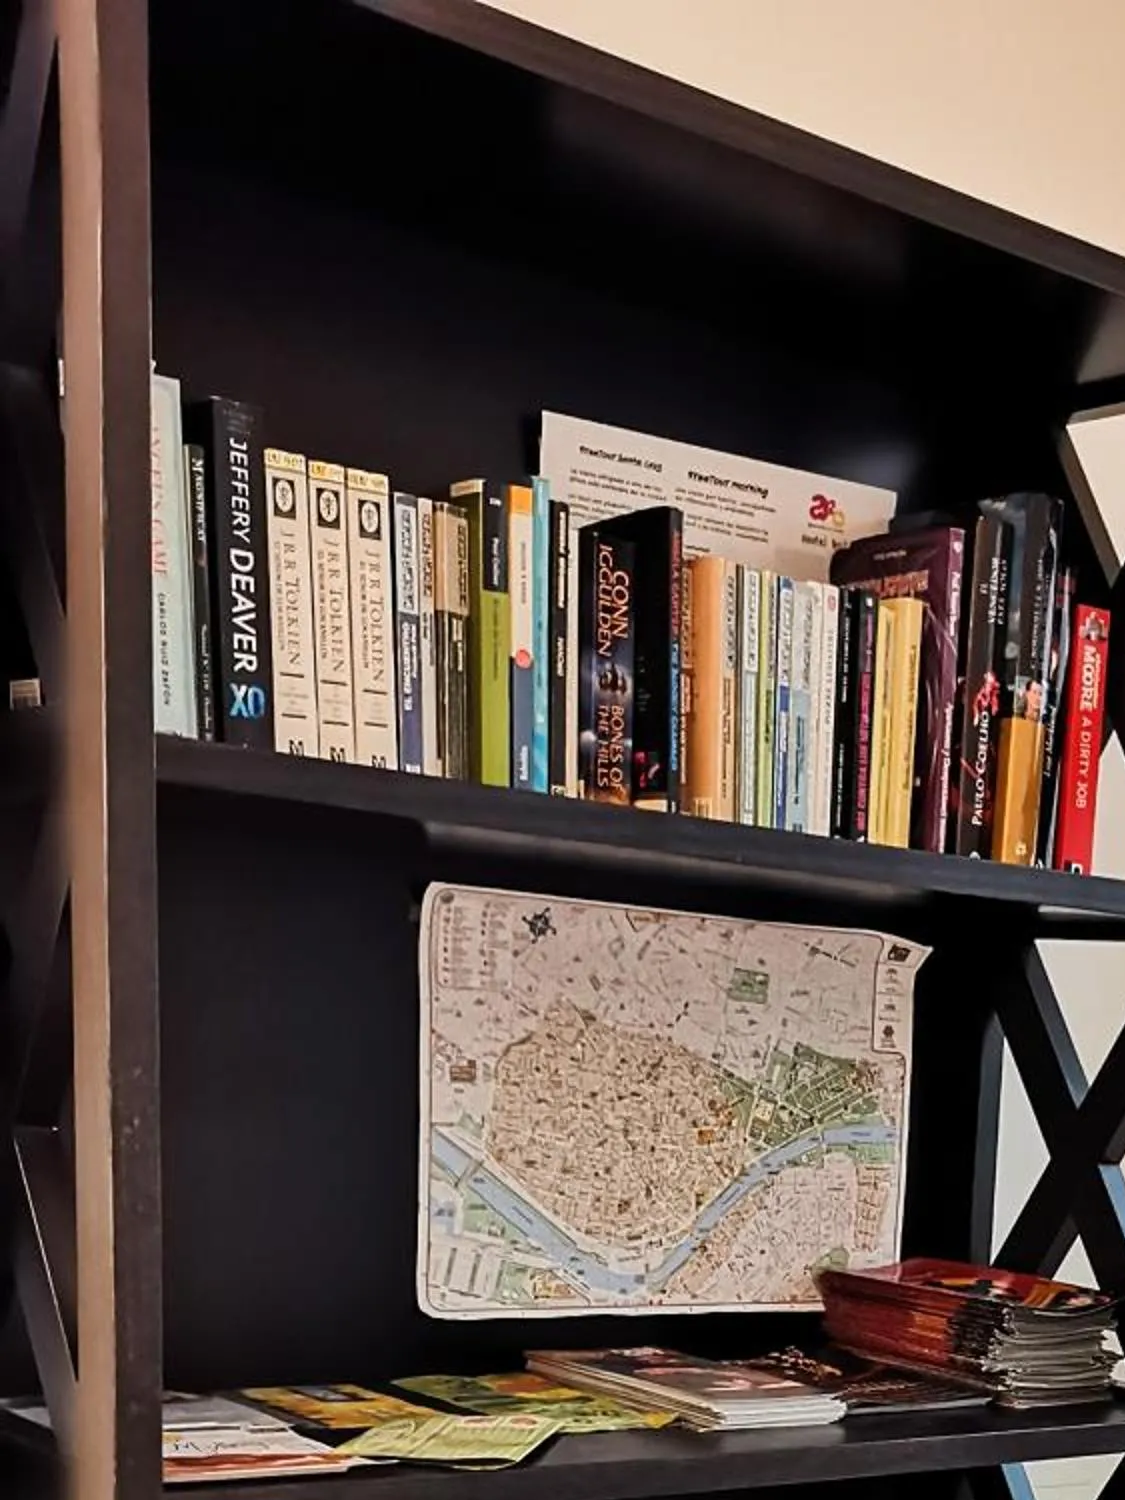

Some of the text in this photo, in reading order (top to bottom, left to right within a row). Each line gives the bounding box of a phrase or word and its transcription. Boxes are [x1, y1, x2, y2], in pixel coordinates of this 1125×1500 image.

[229, 437, 259, 673] JEFFERY DEAVER
[159, 593, 169, 636] CARLOS
[285, 577, 301, 664] TOLKIEN
[329, 588, 345, 672] TOLKIEN
[369, 596, 385, 682] TOLKIEN
[598, 543, 613, 657] IGGULDEN
[612, 571, 629, 639] CONN
[229, 681, 266, 720] XO
[610, 704, 624, 762] BONES
[1075, 644, 1098, 810] MOORE A DIRTY JOB
[597, 735, 610, 787] HILLS
[971, 711, 990, 827] PAULO COELHO
